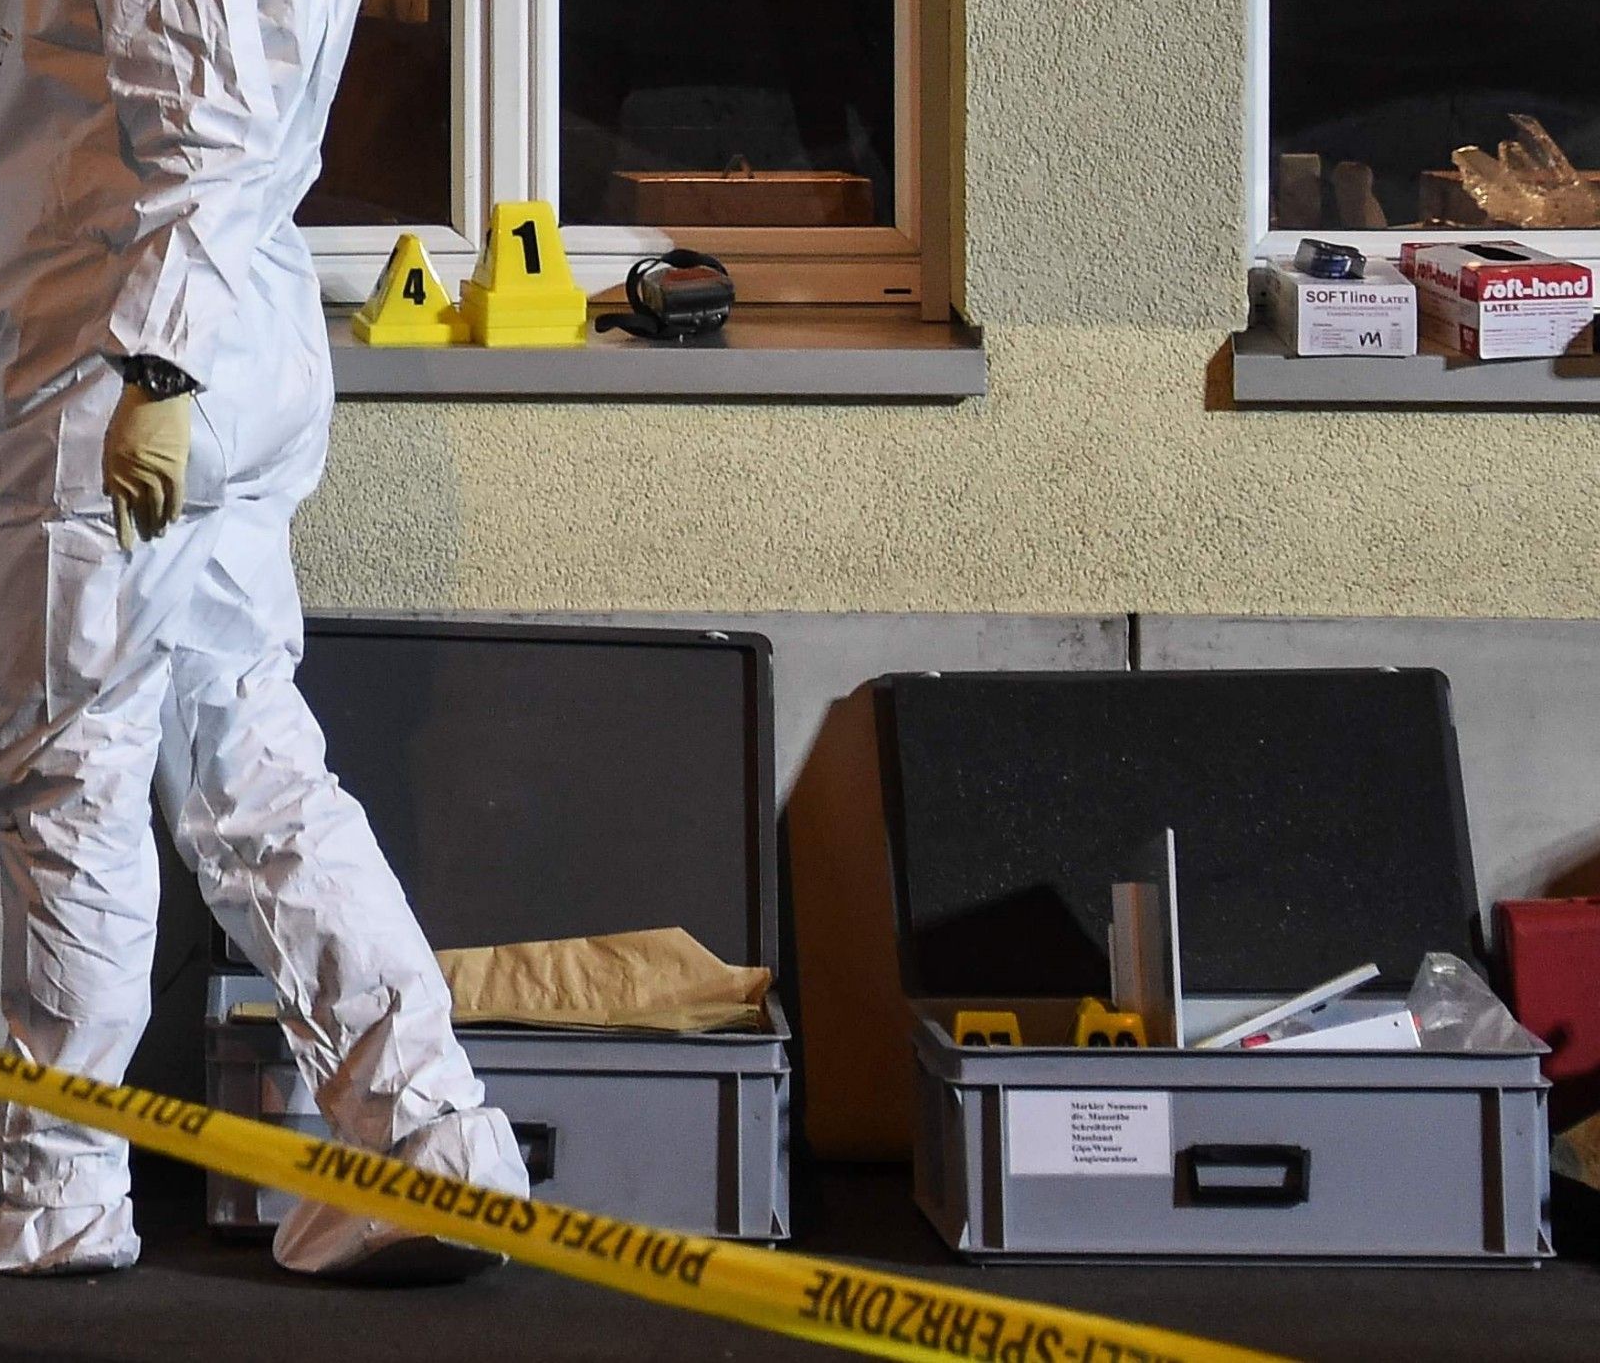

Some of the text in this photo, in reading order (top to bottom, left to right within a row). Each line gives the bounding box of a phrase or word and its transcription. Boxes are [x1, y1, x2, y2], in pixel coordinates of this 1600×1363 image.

[512, 220, 541, 274] 1
[403, 268, 427, 305] 4
[1380, 296, 1410, 304] LATEX
[1484, 303, 1519, 313] LATEX
